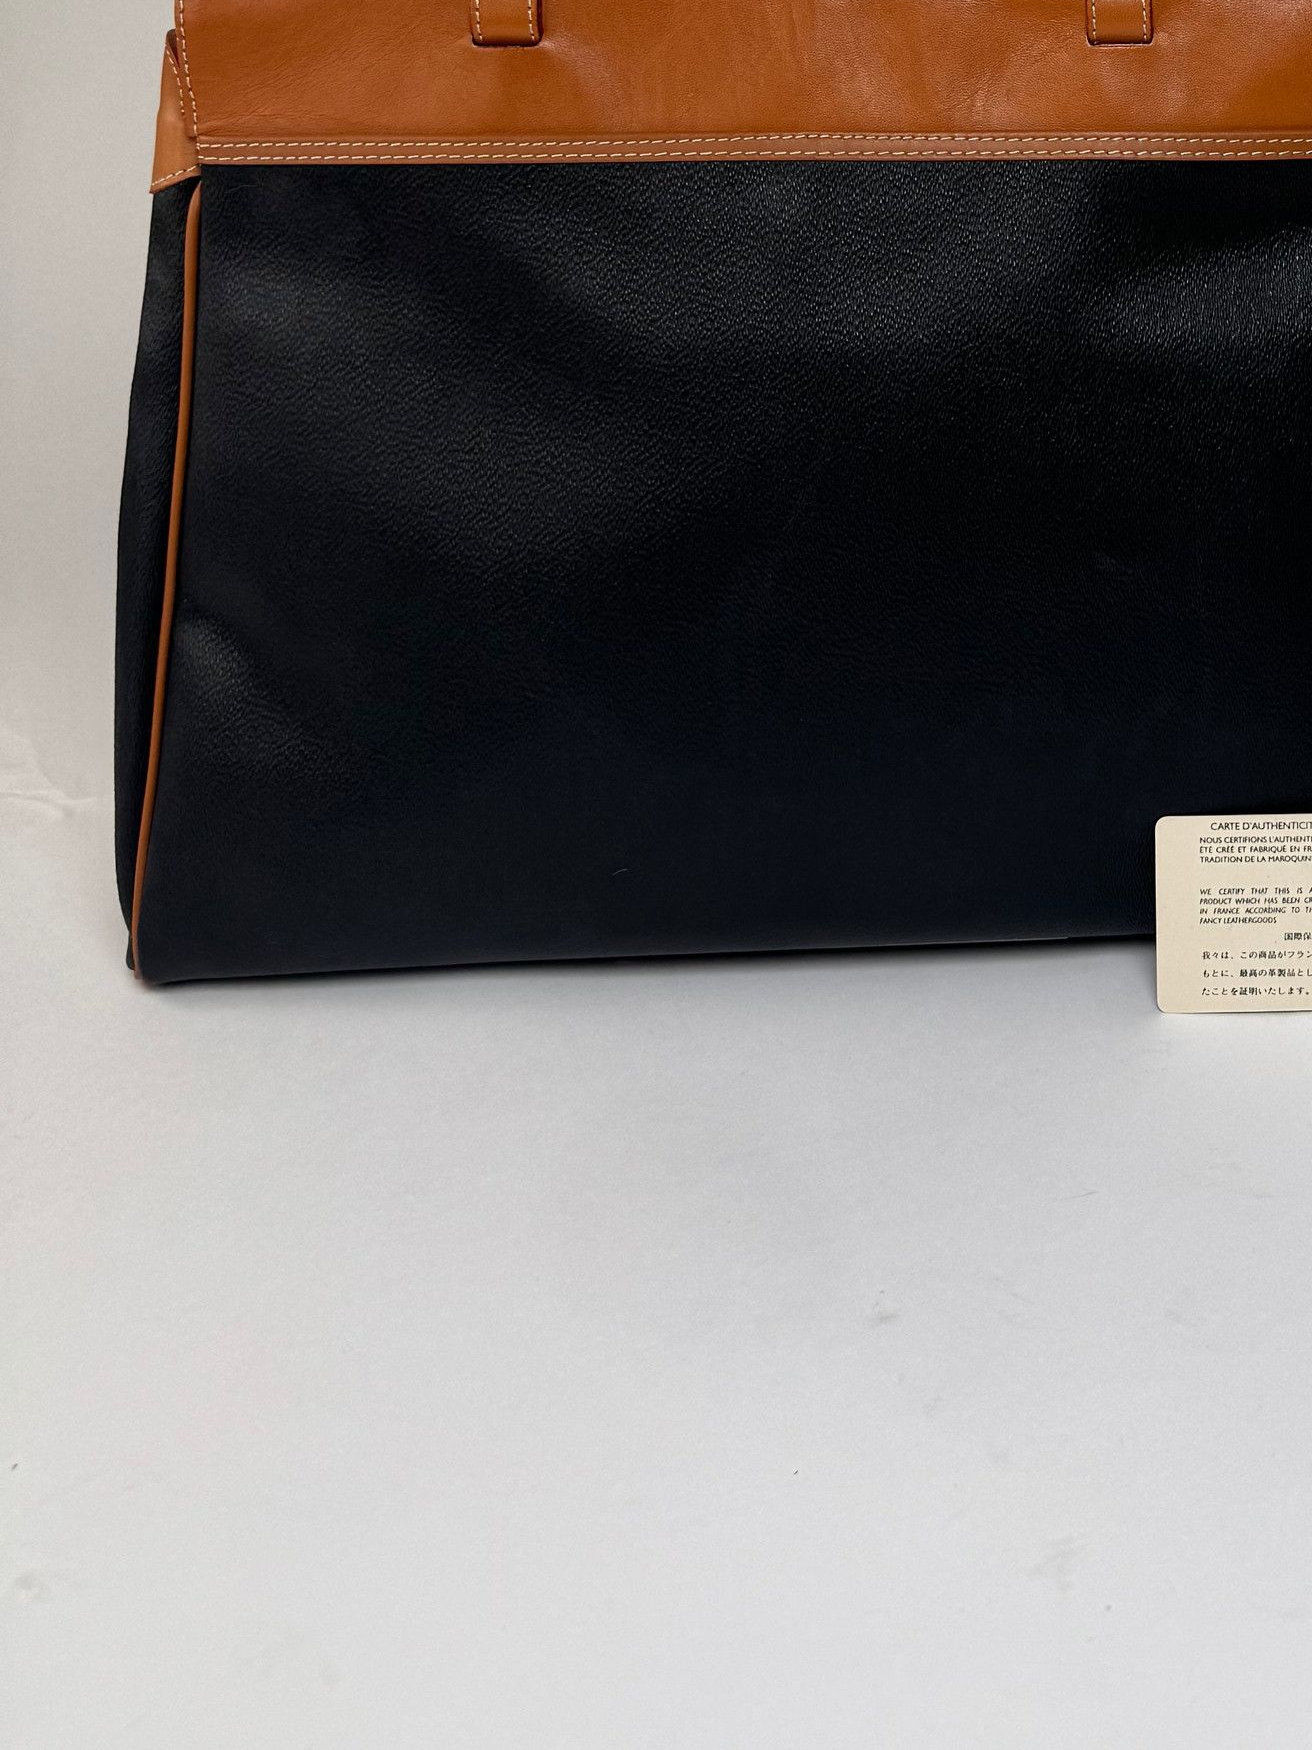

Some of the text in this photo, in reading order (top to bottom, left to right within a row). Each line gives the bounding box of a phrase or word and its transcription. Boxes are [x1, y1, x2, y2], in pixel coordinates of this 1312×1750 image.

[1210, 822, 1240, 830] CARTE
[1199, 836, 1222, 844] NOUS
[1223, 836, 1267, 844] CERTIFIONS
[1216, 845, 1234, 853] CRÉÉ
[1250, 845, 1287, 854] FABRIQUÉ
[1199, 897, 1232, 905] PRODUCT
